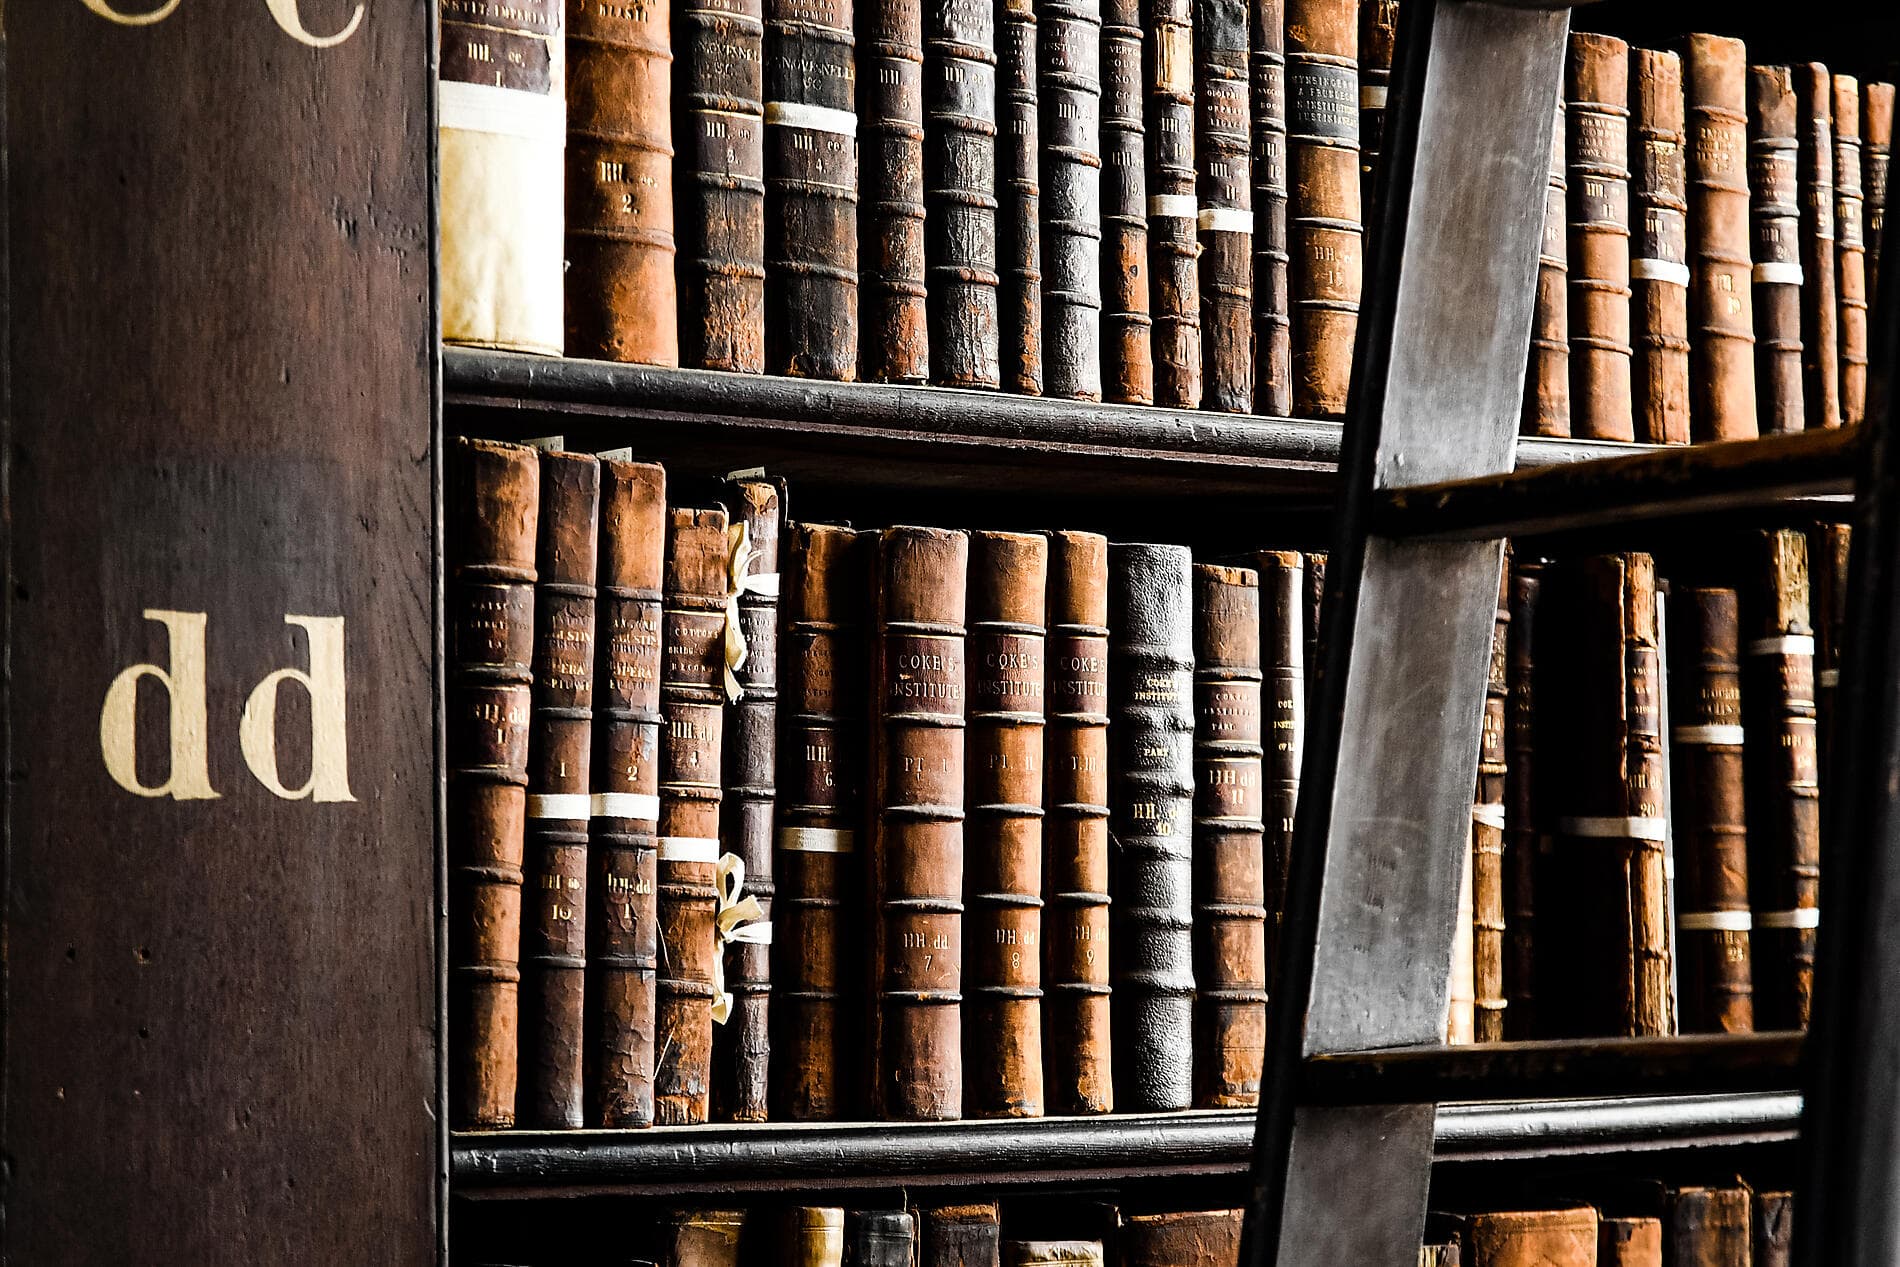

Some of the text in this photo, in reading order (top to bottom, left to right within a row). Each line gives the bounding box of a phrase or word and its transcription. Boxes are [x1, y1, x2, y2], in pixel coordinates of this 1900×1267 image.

[100, 608, 358, 803] dd
[627, 764, 638, 781] 2
[1012, 952, 1020, 968] 8
